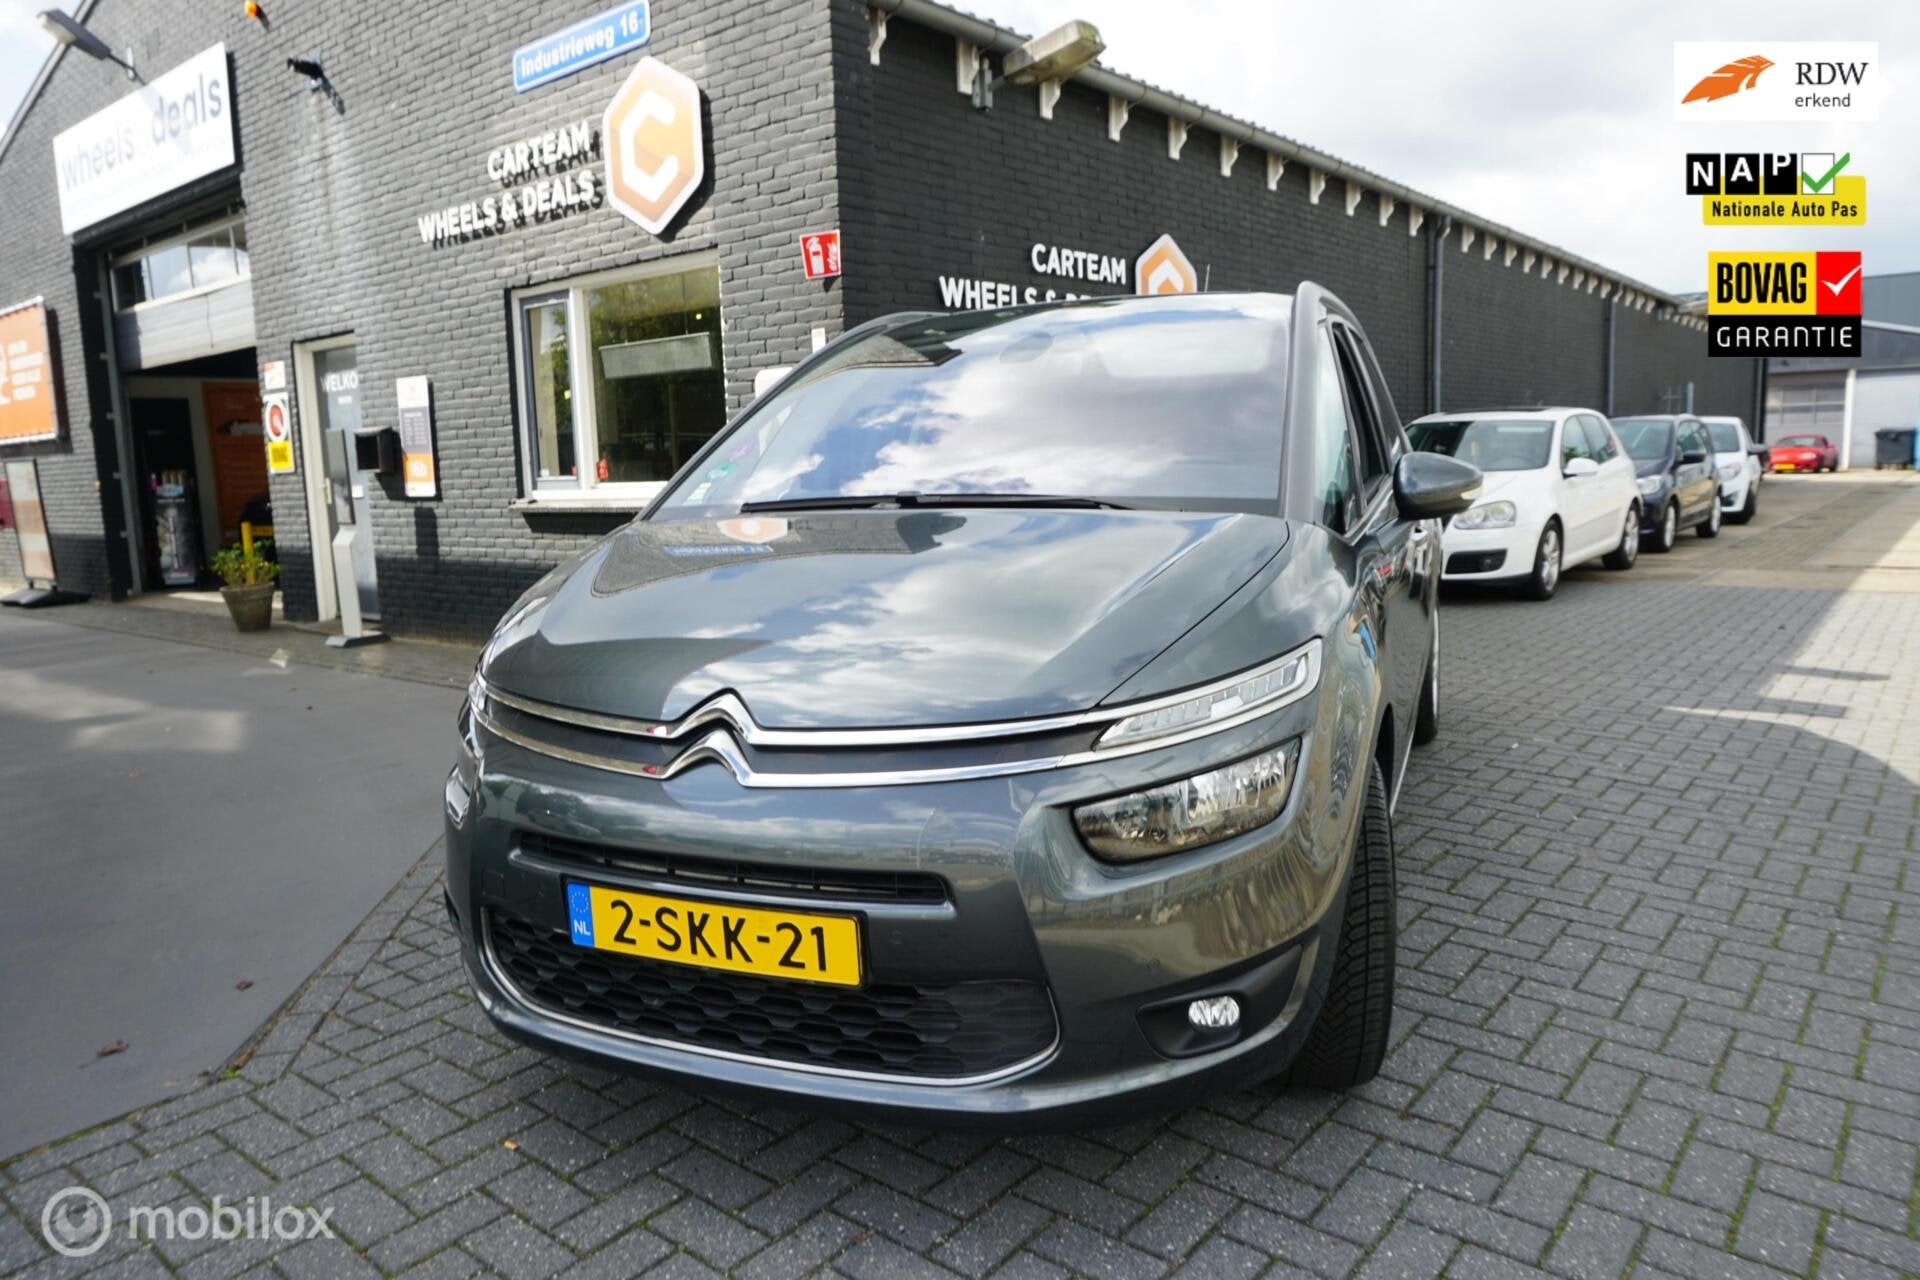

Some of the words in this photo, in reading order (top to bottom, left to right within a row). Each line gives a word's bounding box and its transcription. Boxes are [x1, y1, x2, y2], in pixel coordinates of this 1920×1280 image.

[521, 25, 615, 77] Industrieweg
[619, 11, 638, 37] 16
[152, 73, 222, 145] deals
[487, 120, 591, 181] CARTEAM
[418, 197, 498, 243] WHEELS
[500, 192, 518, 222] &
[521, 170, 595, 217] DEALS
[1031, 243, 1127, 285] CARTEAM
[573, 920, 591, 936] NL
[610, 899, 827, 971] 2-SKK-21
